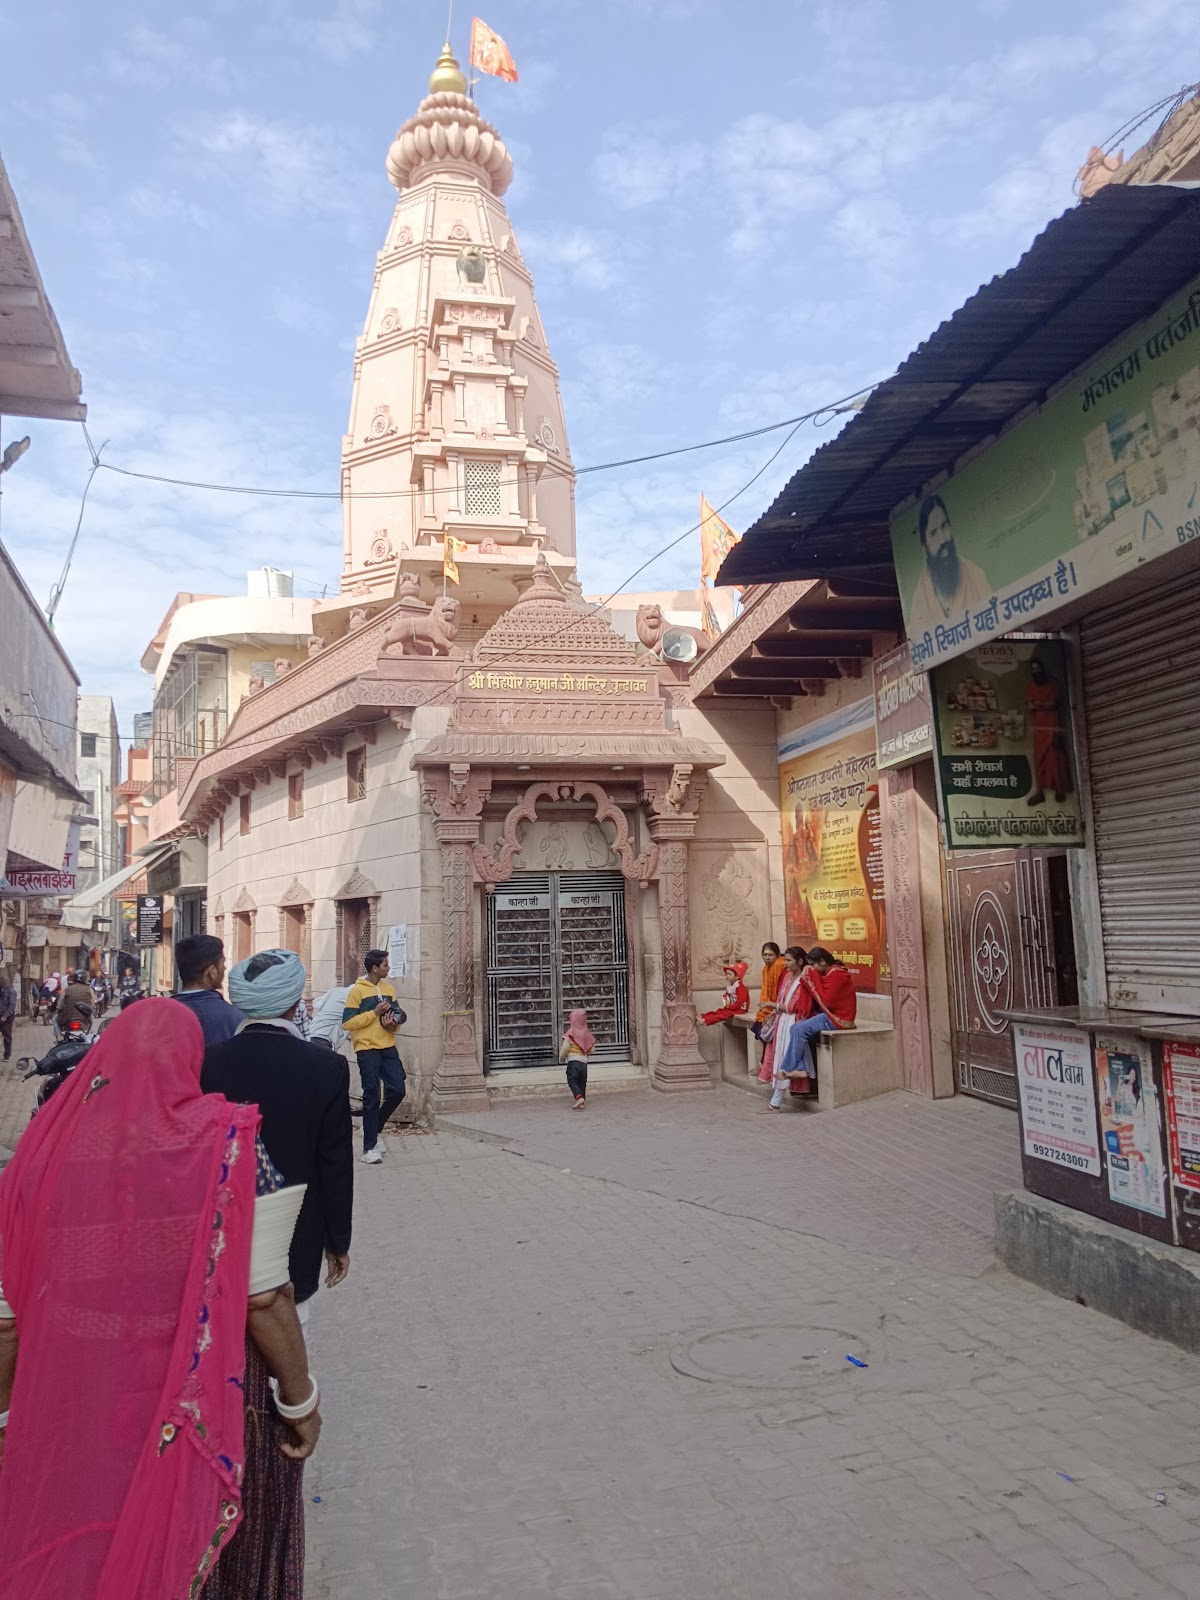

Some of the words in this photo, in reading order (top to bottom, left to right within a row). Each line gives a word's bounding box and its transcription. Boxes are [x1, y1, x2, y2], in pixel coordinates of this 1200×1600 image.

[1080, 347, 1142, 413] मंगलम
[911, 631, 933, 666] सभी
[935, 610, 972, 653] रिचार्ज
[973, 596, 999, 632] यहाँ
[1000, 576, 1054, 621] उपलब्ध
[468, 671, 485, 690] श्री
[525, 677, 559, 694] हनुमान
[559, 673, 575, 692] जी
[611, 679, 648, 696] वृन्दावन
[951, 759, 973, 773] सभी
[1010, 774, 1018, 788] है
[508, 898, 528, 907] कान्हा
[528, 896, 538, 906] जी
[570, 896, 590, 905] कान्हा
[590, 893, 600, 904] जी
[1022, 1044, 1065, 1083] लाल
[1064, 1064, 1085, 1086] बाम
[1033, 1143, 1089, 1169] 9927243007
